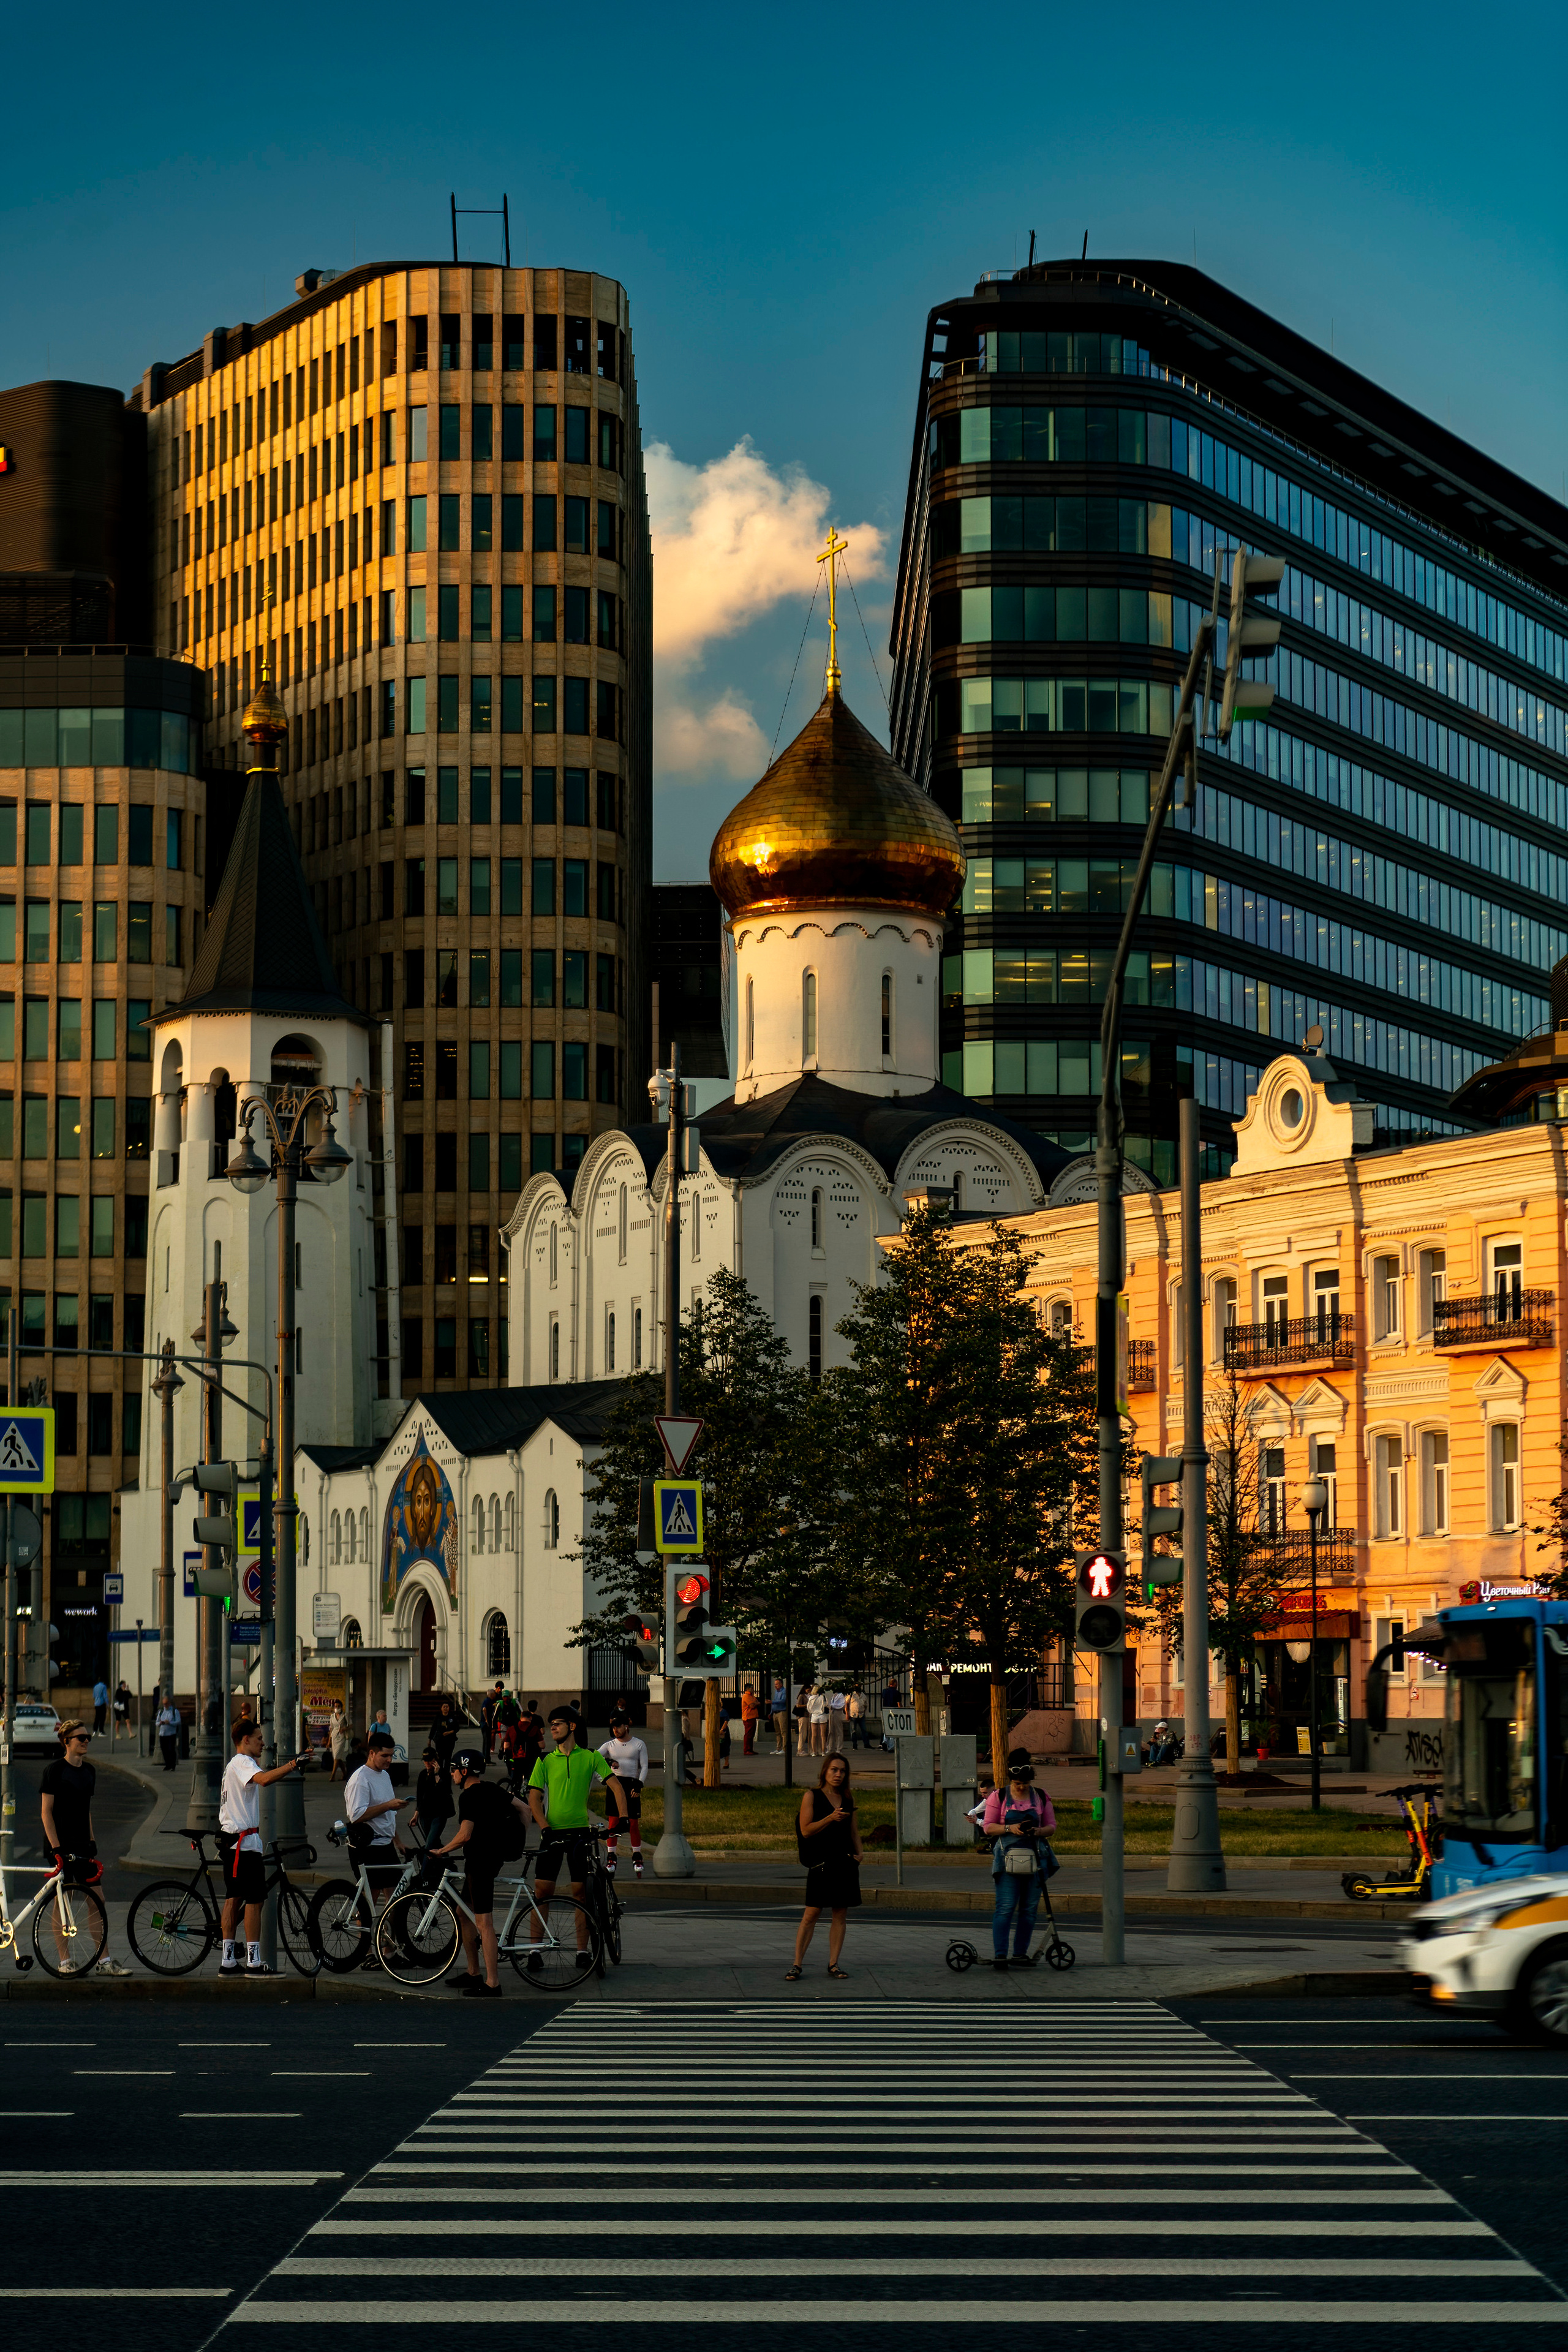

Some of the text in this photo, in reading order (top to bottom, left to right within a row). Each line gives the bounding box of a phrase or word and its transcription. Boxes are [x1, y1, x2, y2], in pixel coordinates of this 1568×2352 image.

[1480, 1581, 1531, 1602] Цветочный
[64, 1605, 98, 1616] wework
[951, 1663, 992, 1673] РЕМОНТ
[888, 1714, 912, 1730] СТОП
